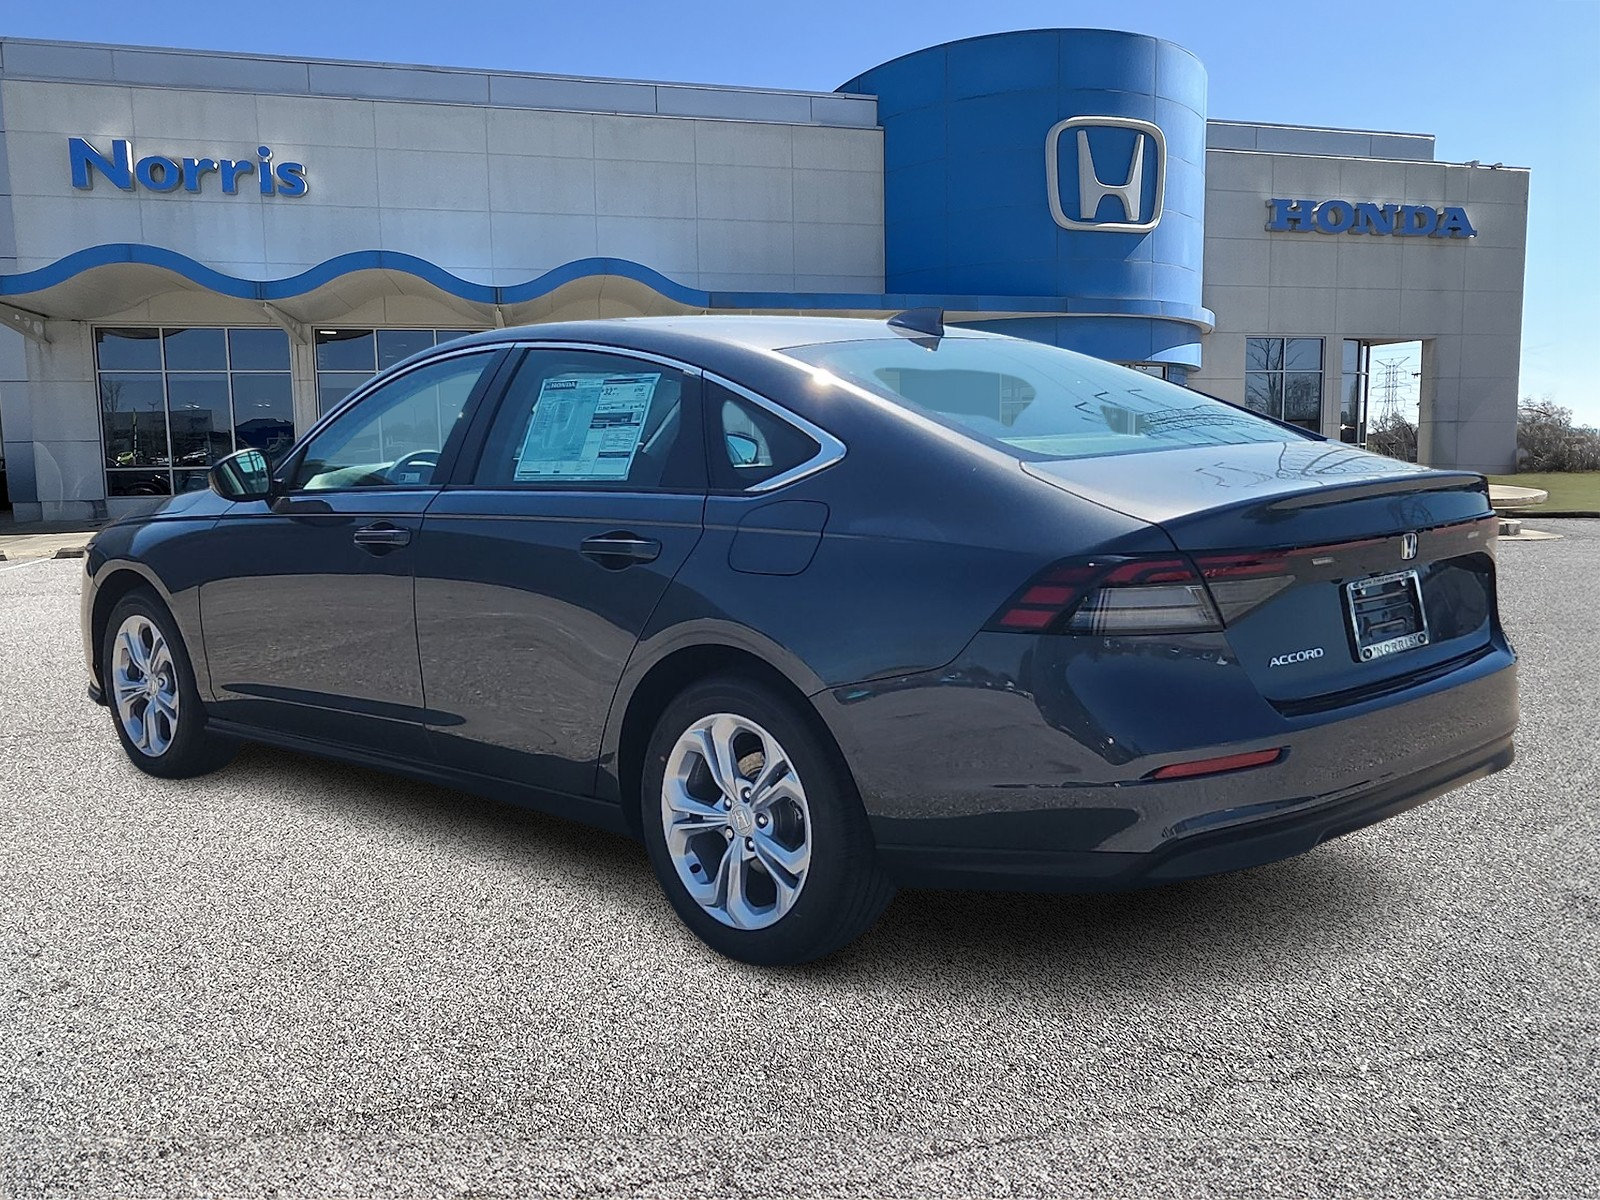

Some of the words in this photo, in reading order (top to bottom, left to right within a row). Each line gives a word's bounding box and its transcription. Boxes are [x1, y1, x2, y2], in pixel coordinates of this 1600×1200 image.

[68, 137, 309, 197] Norris
[1265, 198, 1477, 239] HONDA
[1270, 648, 1324, 668] ACCORD
